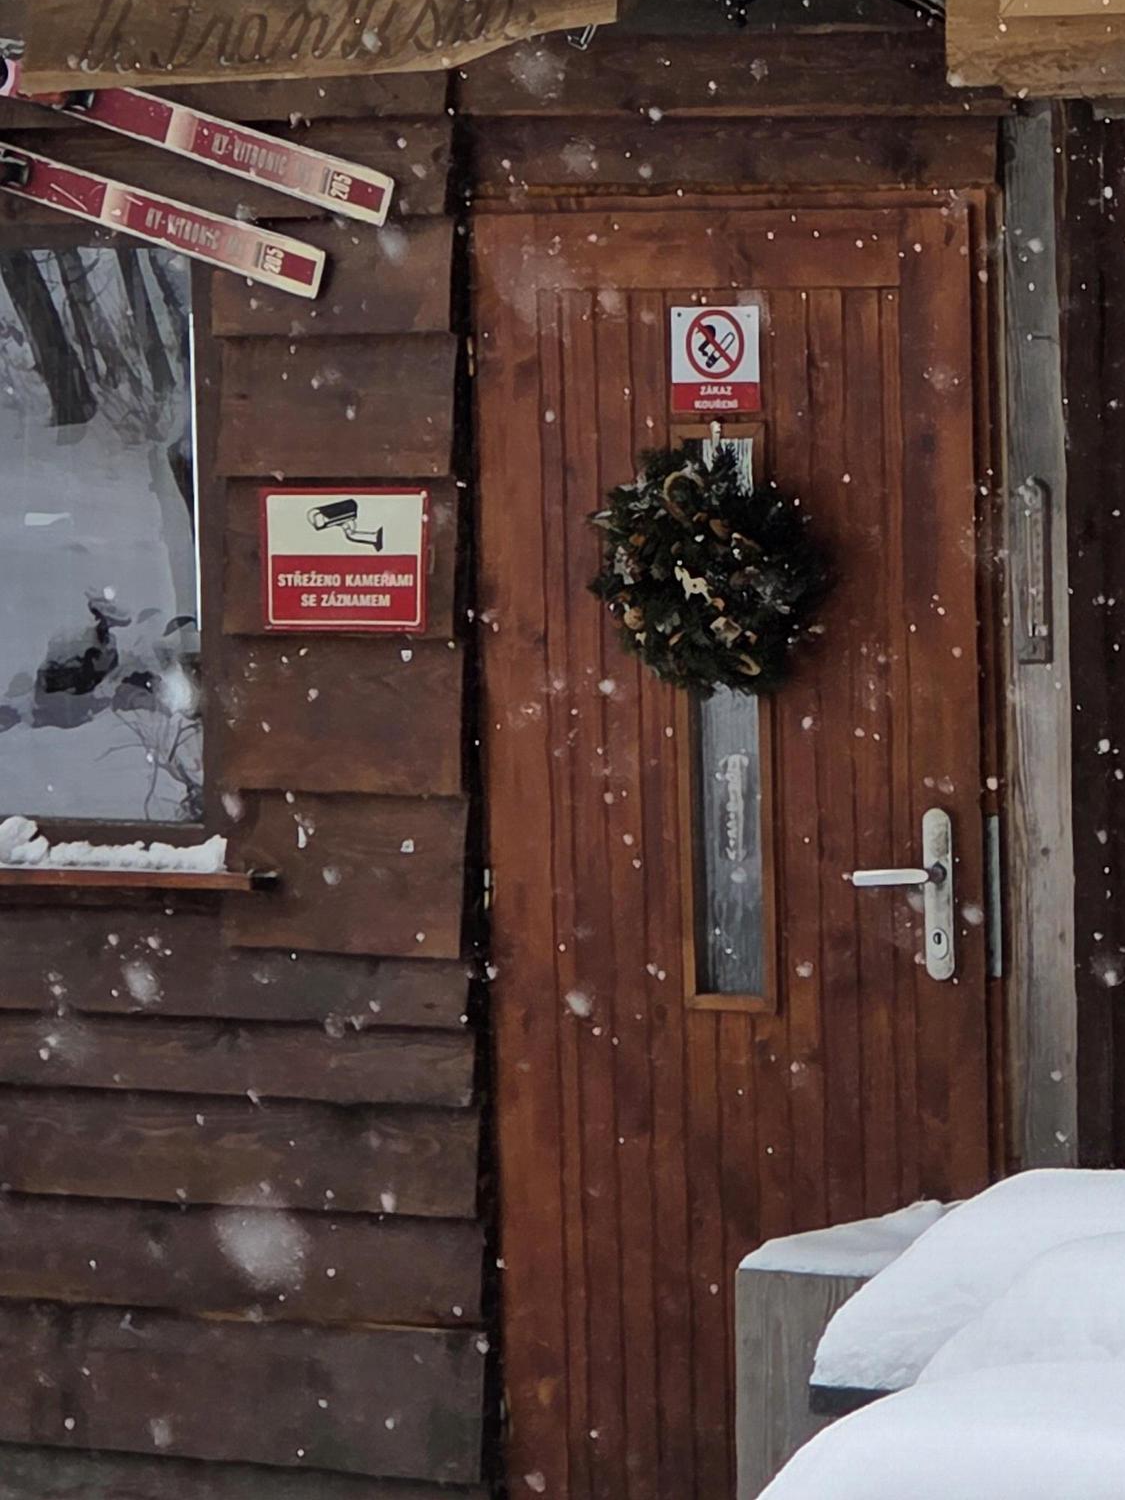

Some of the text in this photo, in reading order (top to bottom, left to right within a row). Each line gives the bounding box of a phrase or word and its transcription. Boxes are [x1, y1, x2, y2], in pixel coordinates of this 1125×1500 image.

[330, 172, 353, 201] 205
[262, 246, 285, 274] 205
[699, 384, 732, 396] ZÁKAZ
[277, 570, 414, 587] STŘEŽENO KAMERAMI
[301, 591, 391, 607] SE ZÁZNAMEM
